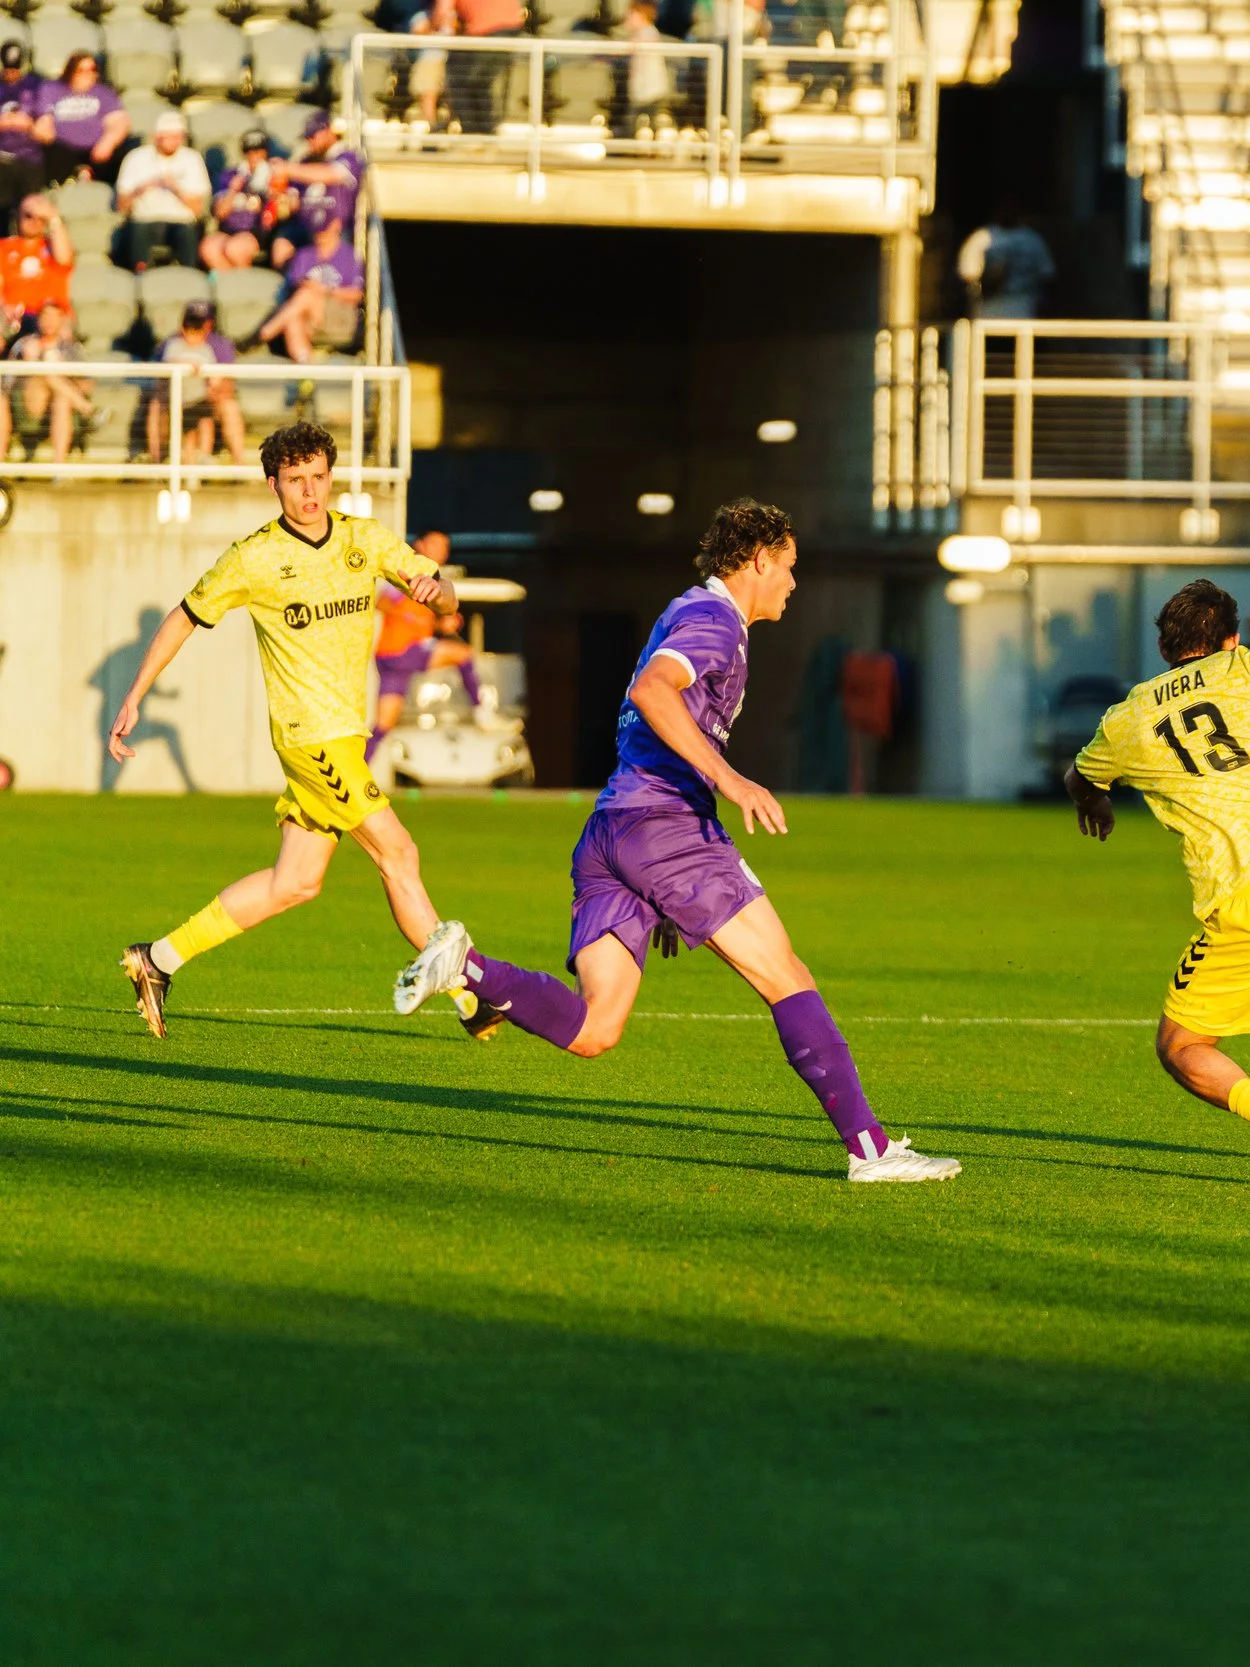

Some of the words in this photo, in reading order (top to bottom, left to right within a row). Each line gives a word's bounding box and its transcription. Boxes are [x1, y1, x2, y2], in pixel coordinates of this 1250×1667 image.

[285, 605, 310, 626] 84
[314, 594, 371, 621] LUMBER
[1154, 669, 1206, 706] VIERA
